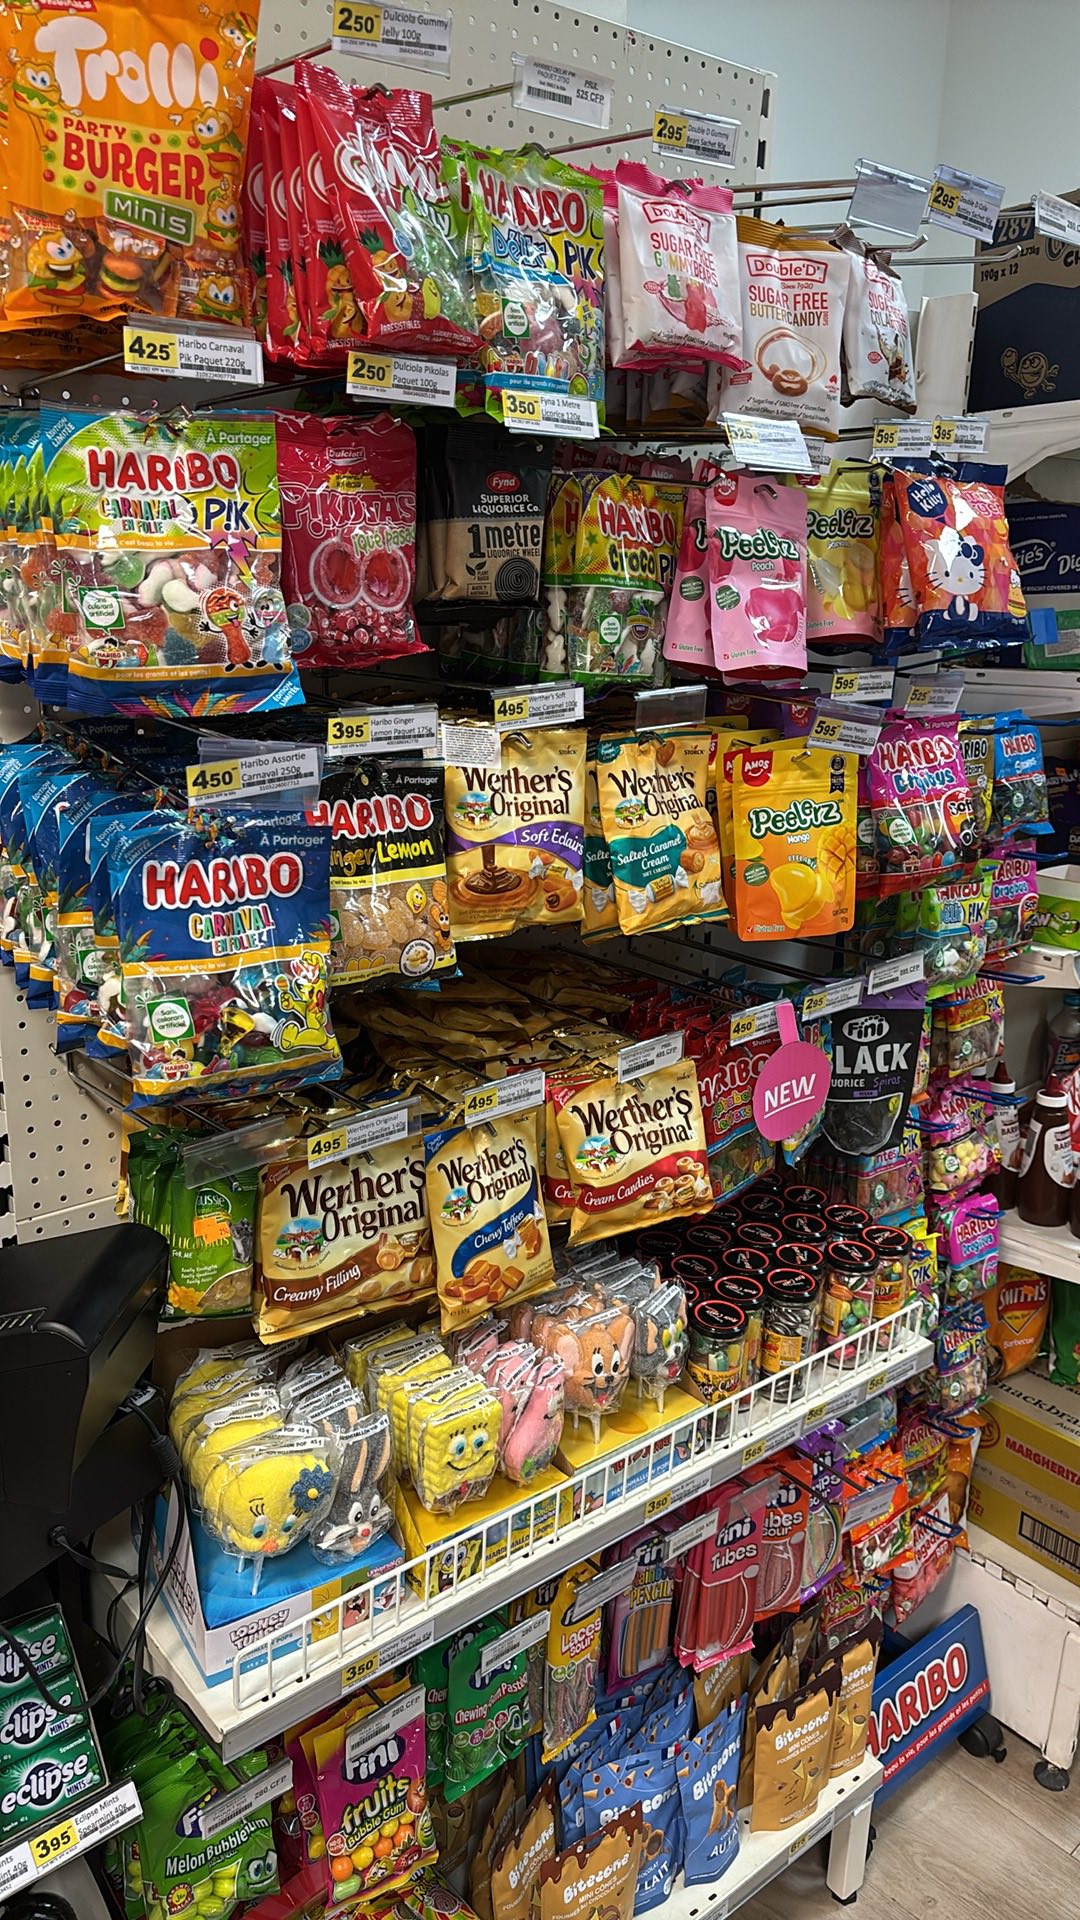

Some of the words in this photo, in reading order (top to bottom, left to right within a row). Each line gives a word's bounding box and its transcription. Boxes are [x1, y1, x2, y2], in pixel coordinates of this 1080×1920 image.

[383, 5, 416, 25] Dulciola
[417, 13, 449, 31] Gummy
[382, 25, 399, 41] Jelly
[402, 29, 422, 42] 100g
[34, 15, 219, 108] Trolli
[63, 117, 126, 140] PARTY
[63, 132, 206, 206] BURGER
[479, 166, 587, 236] HARIBO
[114, 197, 187, 236] Minis
[651, 232, 692, 258] SUGAR
[694, 247, 715, 271] FREE
[980, 267, 999, 282] 190g
[1009, 263, 1018, 274] 12
[749, 284, 789, 310] SUGAR
[793, 292, 829, 311] FREE
[750, 303, 823, 327] BUTTERCANDY
[128, 336, 171, 361] 425
[179, 339, 207, 351] Haribo
[208, 341, 245, 355] Carnaval
[179, 353, 193, 364] Pik
[194, 354, 223, 368] Paquet
[225, 358, 246, 369] 220g
[352, 358, 386, 382] 250
[393, 361, 422, 375] Dulciola
[424, 365, 449, 377] Pikolas
[393, 375, 420, 388] Paquet
[420, 378, 438, 391] 100g
[508, 395, 536, 415] 350
[541, 397, 555, 410] Fyna
[561, 401, 581, 411] Metre
[541, 409, 564, 420] Licorice
[207, 428, 217, 444] À
[217, 431, 272, 446] Partager
[87, 449, 238, 491] HARIBO
[480, 493, 529, 504] SUPERIOR
[911, 479, 936, 502] Hello
[919, 492, 942, 512] Kitty
[99, 495, 180, 520] CARNAVAL
[472, 504, 526, 515] LIQUORICE
[527, 503, 541, 514] Co.
[122, 520, 134, 534] EN
[136, 520, 163, 535] FOLIE
[599, 498, 677, 548] HARIBO
[807, 510, 874, 539] Peelerz
[468, 524, 486, 559] 1
[486, 523, 541, 549] metre
[487, 548, 521, 558] LIQUORICE
[720, 527, 799, 560] Peelerz
[752, 560, 774, 572] Peach
[497, 699, 524, 716] 495
[528, 704, 541, 713] Choc
[542, 702, 564, 712] Caramel
[565, 700, 578, 710] 100g
[528, 693, 552, 705] Werther's
[553, 691, 567, 700] Soft
[332, 722, 365, 741] 395
[371, 718, 393, 729] Haribo
[394, 716, 415, 730] Ginger
[371, 727, 392, 739] Lemon
[393, 726, 416, 739] Paquet
[417, 724, 433, 737] 175g
[241, 758, 269, 771] Haribo
[271, 751, 306, 766] Assortie
[745, 758, 770, 773] AMOS
[879, 736, 955, 772] HARIBO
[192, 769, 234, 791] 450
[241, 768, 277, 782] Carnaval
[281, 765, 302, 778] 250g
[405, 774, 439, 786] Partager
[458, 766, 573, 797] Werther's
[608, 765, 695, 799] Werther's
[304, 793, 433, 840] HARIBO
[492, 795, 570, 825] Original
[644, 792, 704, 820] Original
[748, 799, 843, 840] Peelerz
[261, 834, 270, 846] À
[272, 834, 325, 847] Partager
[376, 837, 435, 864] Lemon
[521, 830, 550, 844] Soft
[551, 828, 584, 856] Eclairs
[649, 834, 682, 856] Caramel
[787, 833, 810, 844] Mango
[617, 848, 649, 868] Salted
[641, 853, 670, 871] Cream
[144, 855, 300, 907] HARIBO
[190, 904, 275, 940] CARNAVAL
[215, 936, 228, 955] EN
[228, 931, 258, 953] FOLIE
[847, 1018, 884, 1038] Fini
[835, 1042, 912, 1075] LACK
[763, 1072, 817, 1113] NEW
[347, 1124, 372, 1136] Werthers
[373, 1114, 399, 1128] Original
[571, 1087, 694, 1138] Werther's
[311, 1138, 341, 1156] 495
[348, 1135, 366, 1146] Cream
[366, 1127, 391, 1140] Candies
[607, 1113, 694, 1157] Original
[437, 1137, 527, 1192] Werther's
[281, 1156, 427, 1218] Werther's
[465, 1164, 533, 1205] Original
[583, 1190, 616, 1207] Cream
[616, 1171, 656, 1202] Candies
[321, 1188, 426, 1241] Original
[473, 1227, 502, 1251] Chewy
[500, 1210, 525, 1236] Toffees
[273, 1283, 324, 1303] Creamy
[325, 1263, 362, 1294] Filling
[711, 1544, 758, 1574] Tubes
[228, 1607, 290, 1644] LOONEY
[560, 1620, 602, 1654] Laces
[49, 1719, 70, 1736] MINTS
[775, 1711, 830, 1751] Bitecone
[345, 1740, 400, 1780] Fini
[1, 1755, 89, 1814] eclipse
[66, 1779, 87, 1797] MINTS
[74, 1807, 100, 1826] Eclipse
[100, 1794, 120, 1811] Mints
[341, 1774, 410, 1831] fruits
[382, 1801, 405, 1821] Gum
[34, 1830, 72, 1860] 395
[77, 1813, 113, 1836] Spearmint
[113, 1803, 128, 1817] 40g
[346, 1817, 382, 1849] Bubble
[165, 1852, 205, 1877] Melon
[644, 1860, 670, 1891] LAIT
[563, 1852, 630, 1905] Bitecone
